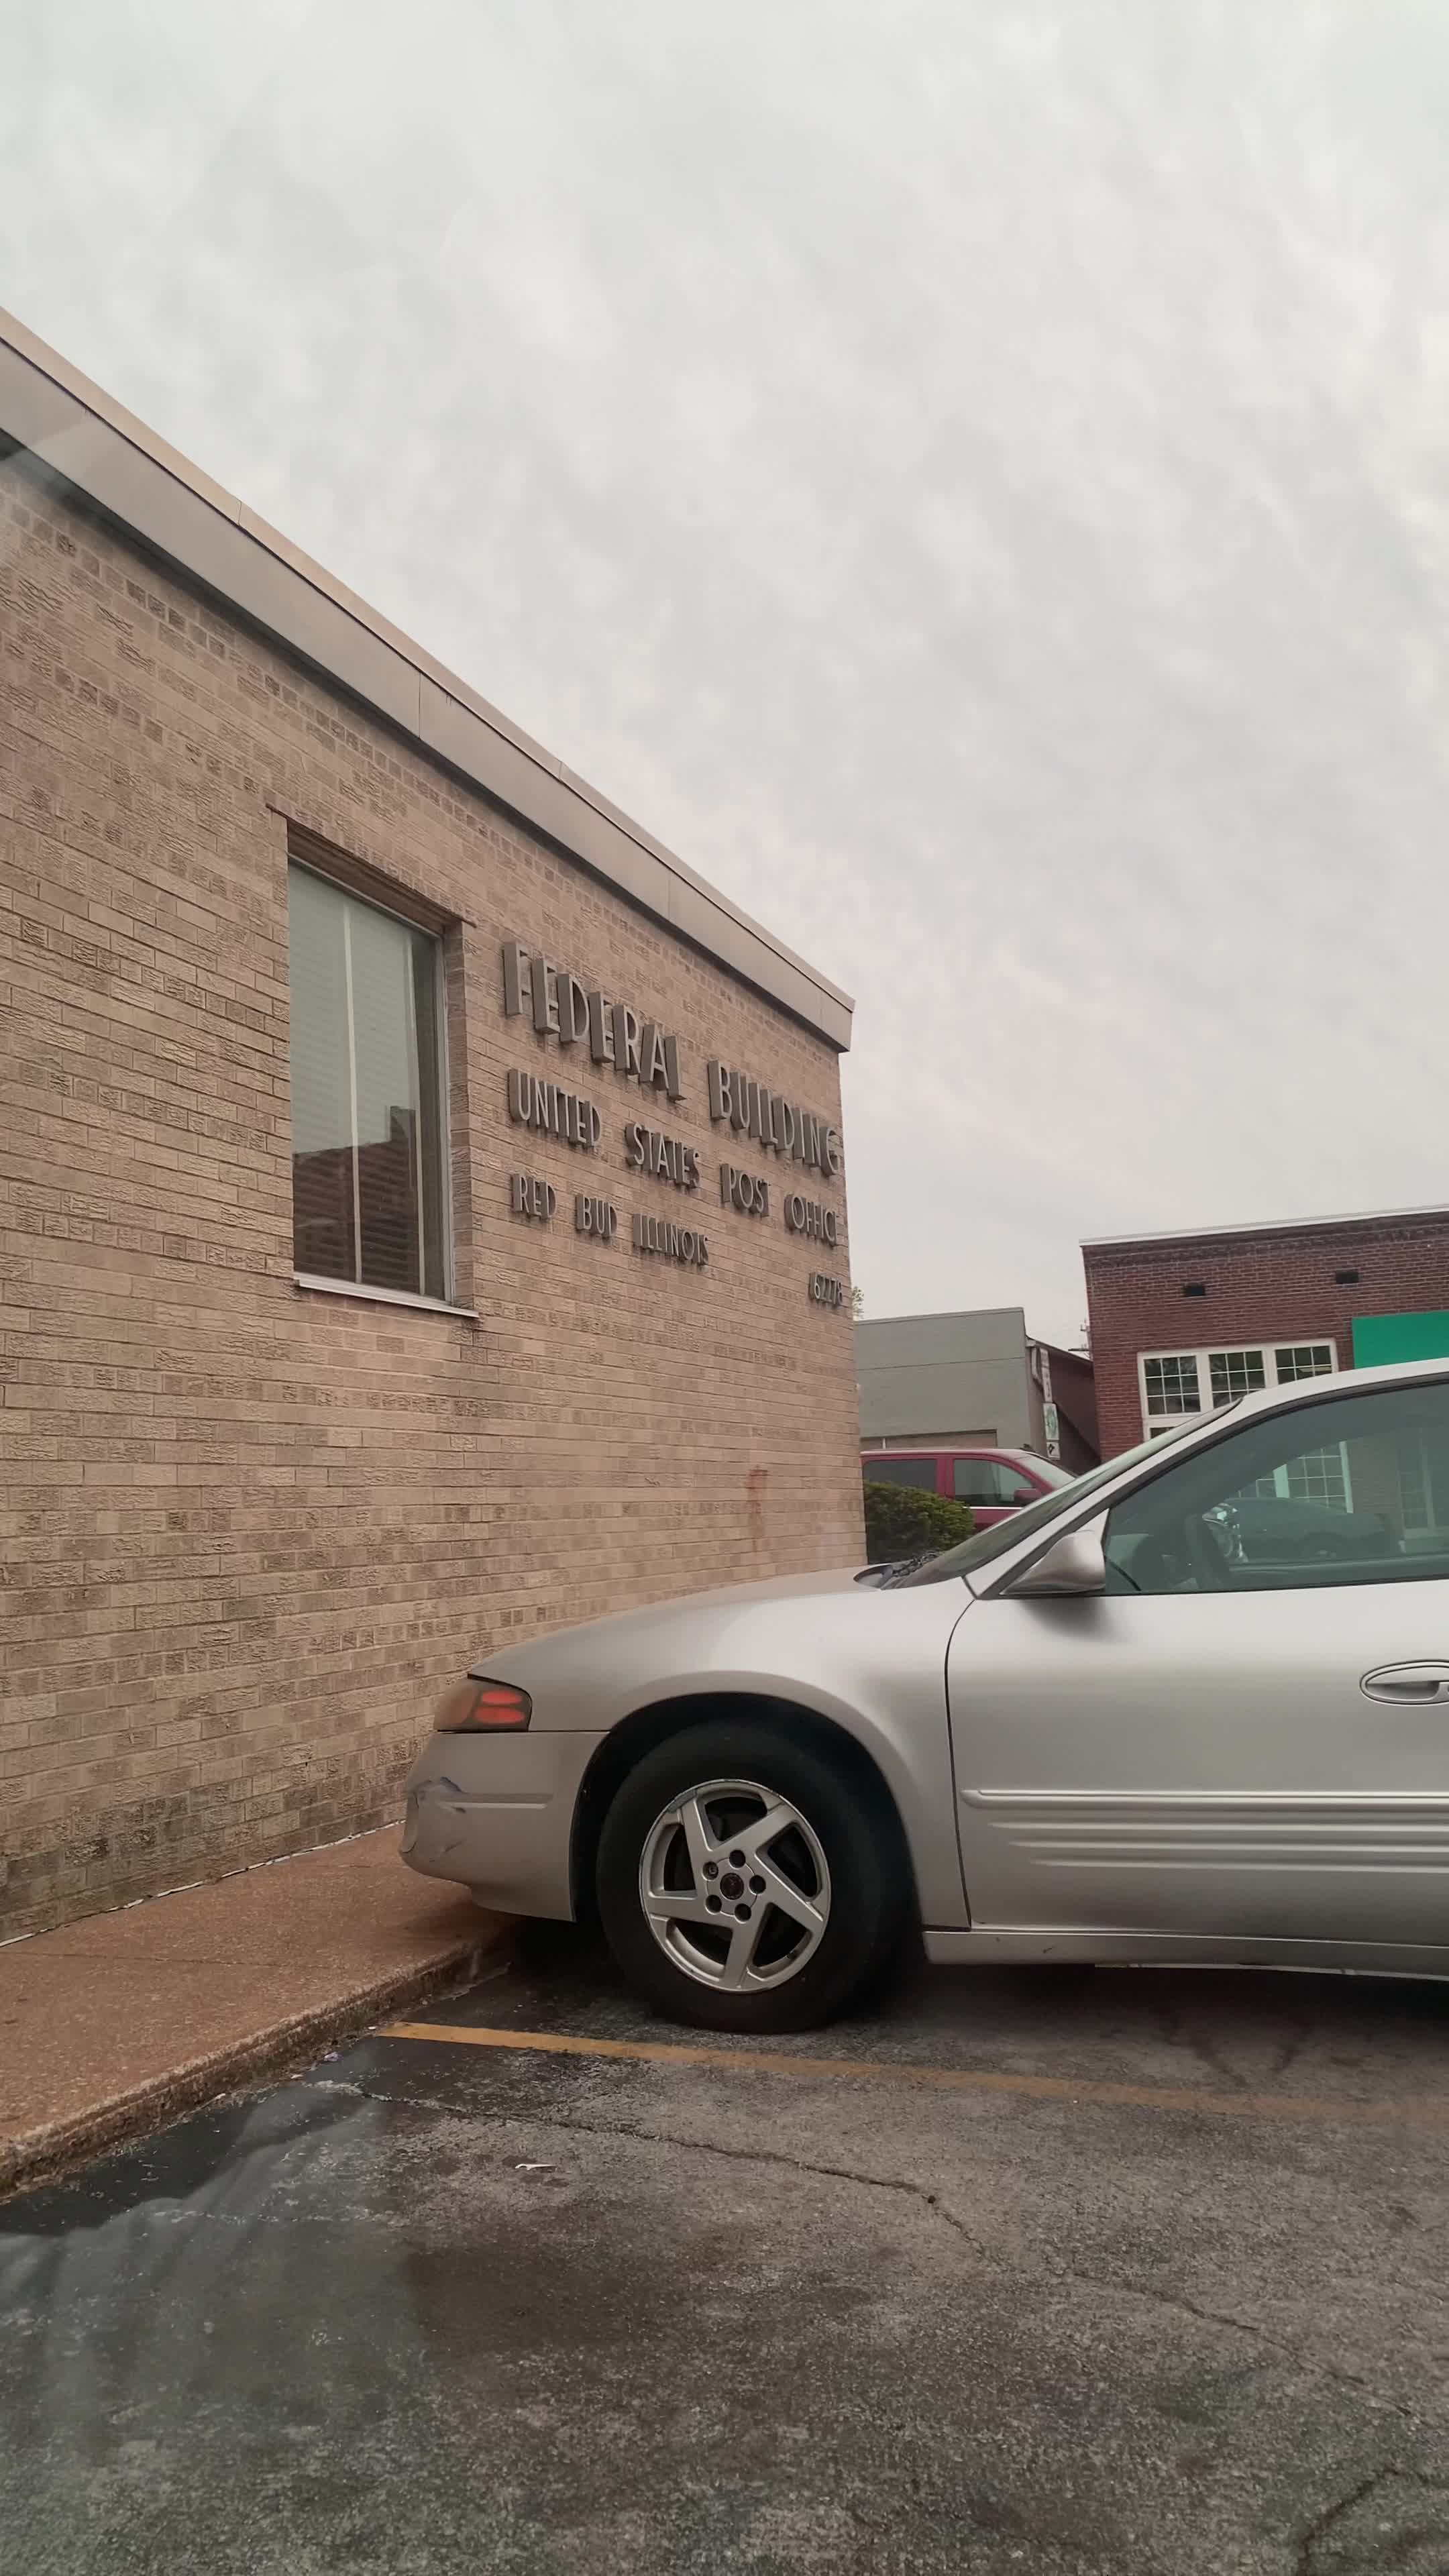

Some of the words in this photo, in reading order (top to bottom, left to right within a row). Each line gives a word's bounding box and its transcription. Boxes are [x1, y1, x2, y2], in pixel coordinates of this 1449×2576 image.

[503, 943, 686, 1102] FEDERAL
[708, 1059, 840, 1175] BUILDING
[508, 1069, 601, 1148] UNITED
[625, 1122, 700, 1188] STATES
[720, 1164, 771, 1218] POST
[510, 1174, 556, 1219] RED
[575, 1194, 617, 1236] BUD
[633, 1214, 709, 1266] ILLINOIS
